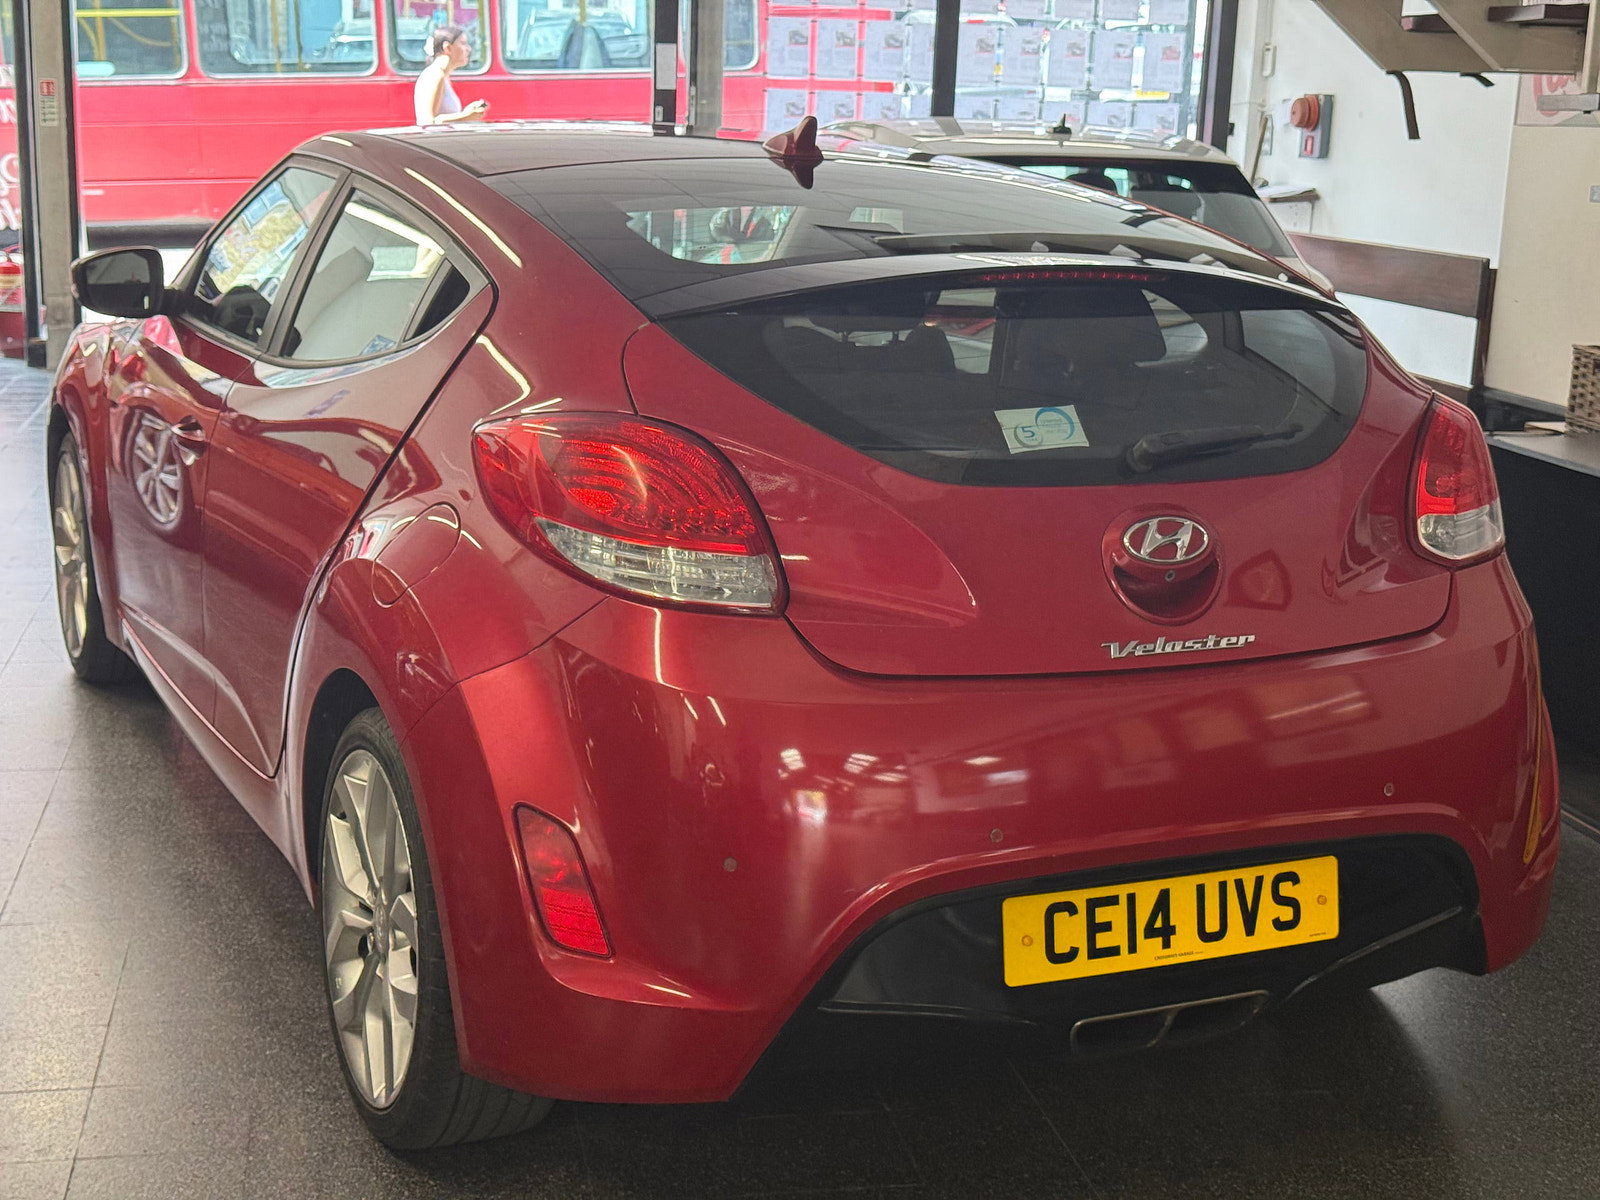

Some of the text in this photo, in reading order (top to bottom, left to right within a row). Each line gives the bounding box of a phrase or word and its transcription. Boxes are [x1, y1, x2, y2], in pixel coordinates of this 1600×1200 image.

[1101, 635, 1256, 659] Veloster
[1043, 871, 1302, 965] CE14 UVS
